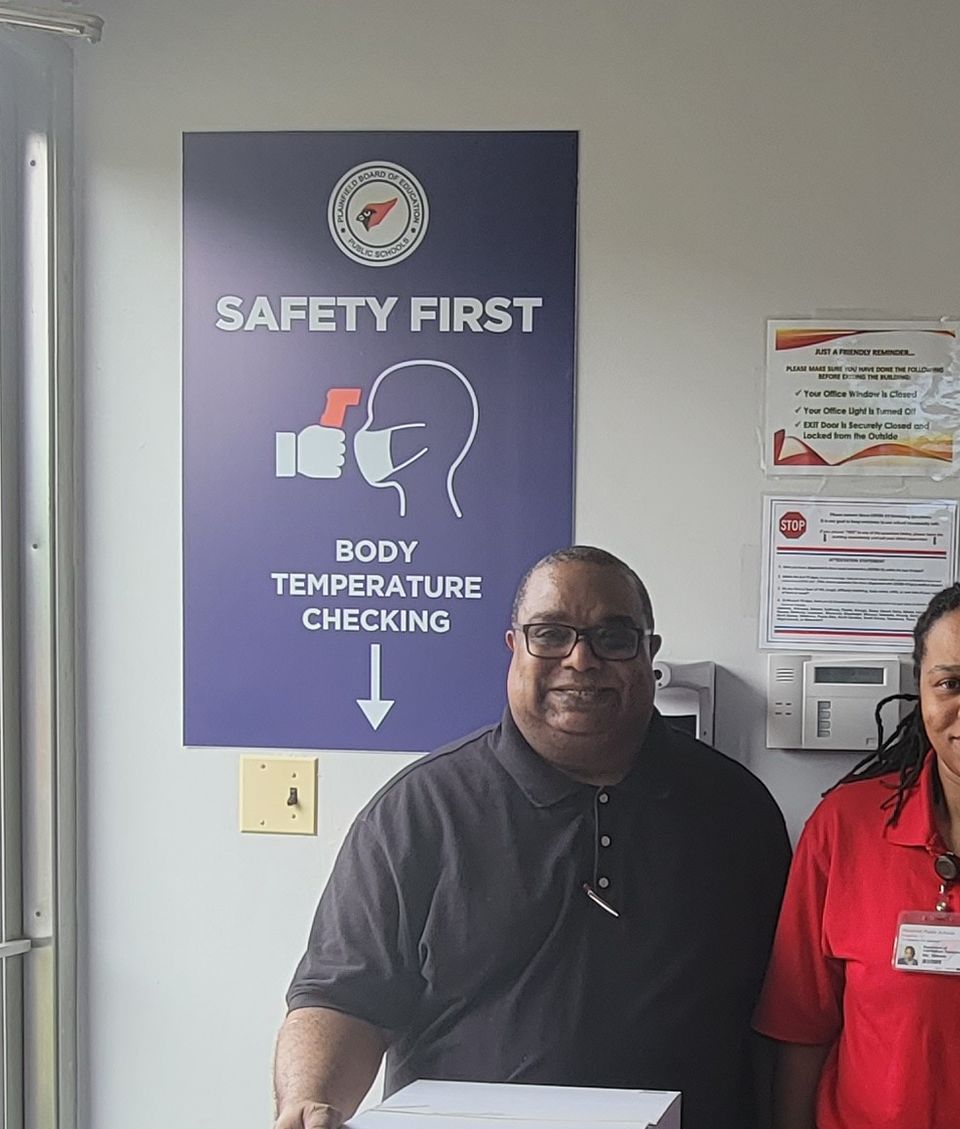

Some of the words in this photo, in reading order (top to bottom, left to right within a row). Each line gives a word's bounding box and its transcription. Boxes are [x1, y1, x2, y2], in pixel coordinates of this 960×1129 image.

[337, 180, 358, 223] PLAINFIELD
[358, 171, 386, 182] BOARD
[388, 173, 399, 181] OF
[399, 179, 419, 223] EDUCATION
[348, 239, 373, 257] PUBLIC
[375, 238, 409, 257] SCHOOLS
[215, 296, 399, 333] SAFETY
[410, 296, 543, 333] FIRST
[849, 408, 867, 416] Light
[849, 422, 882, 430] Securely
[780, 519, 805, 532] STOP
[335, 538, 418, 564] BODY
[271, 572, 483, 600] TEMPERATURE
[302, 607, 451, 633] CHECKING
